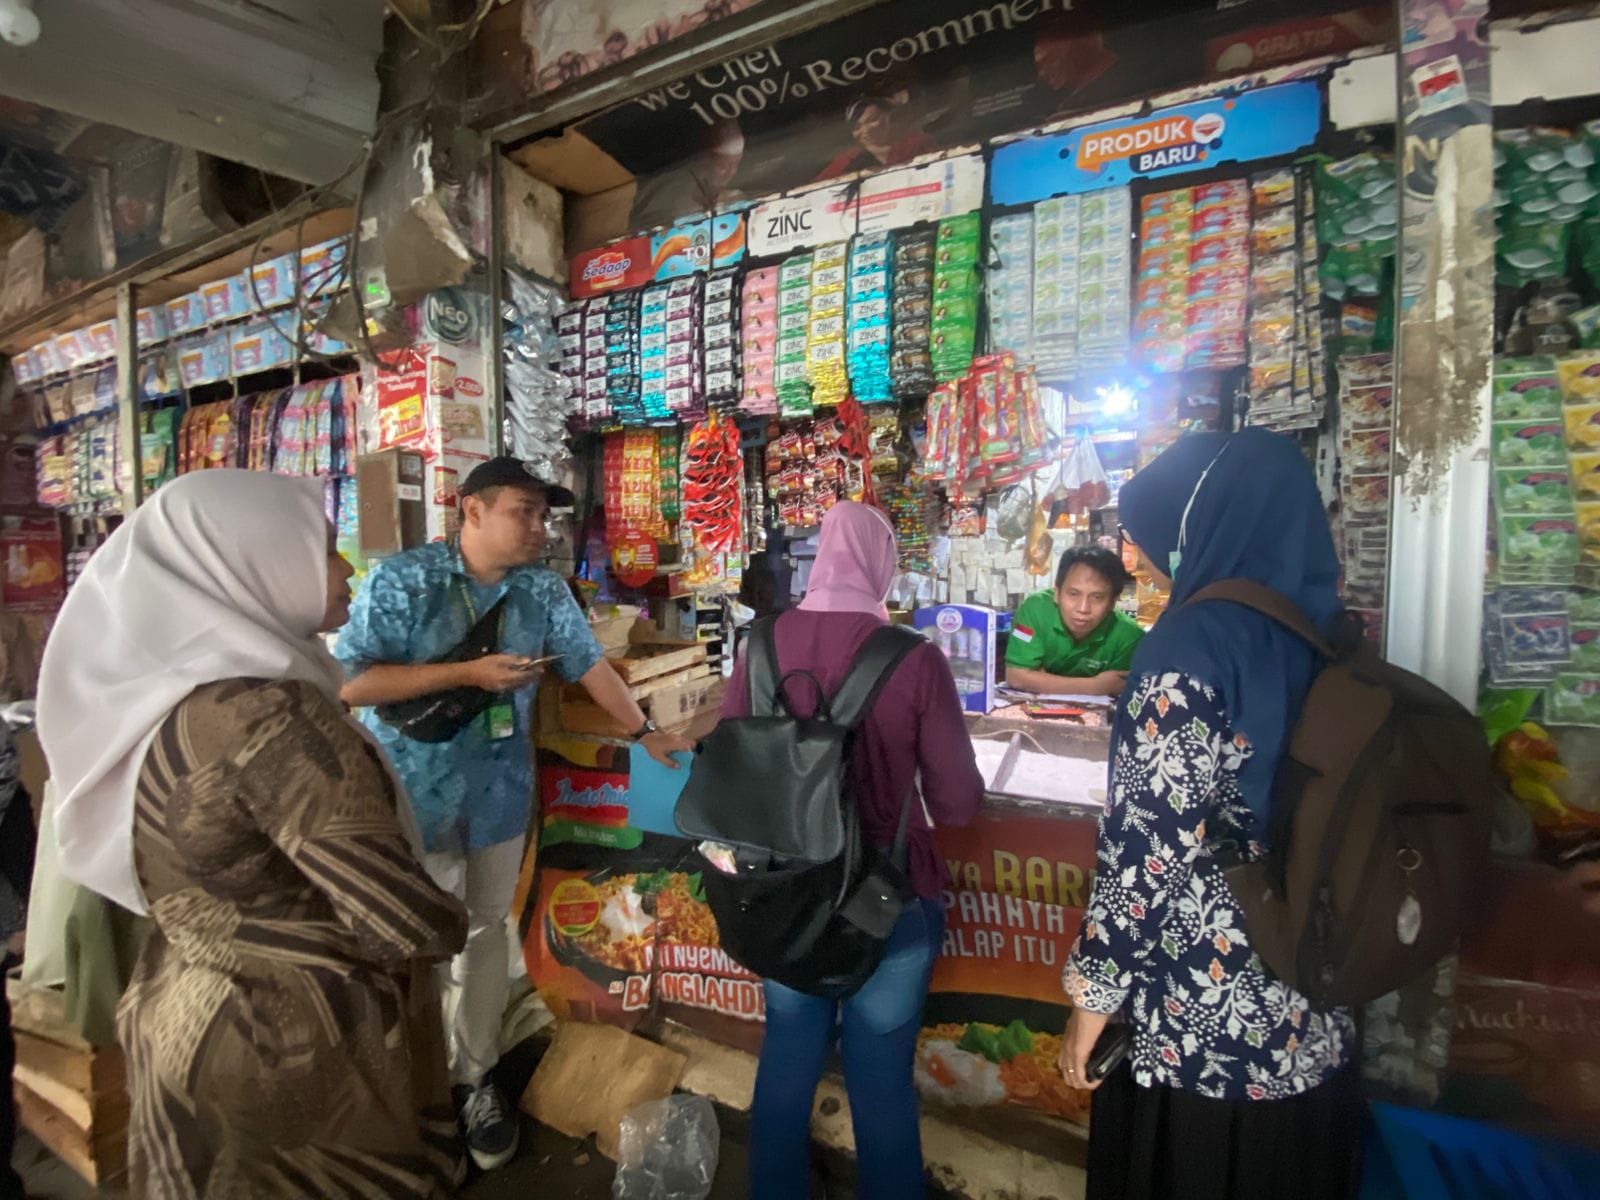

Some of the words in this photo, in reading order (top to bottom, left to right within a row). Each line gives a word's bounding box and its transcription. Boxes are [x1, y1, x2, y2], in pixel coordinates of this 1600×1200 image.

[1255, 27, 1337, 57] GRATIS
[690, 71, 809, 126] 100%
[1085, 120, 1188, 159] PRODUK
[1139, 144, 1197, 171] BARU
[767, 208, 813, 239] ZINC
[820, 247, 838, 258] ZINC
[859, 251, 879, 262] ZINC
[583, 259, 630, 280] Sedaap
[819, 271, 837, 283] ZINC
[858, 276, 879, 288] ZINC
[817, 295, 837, 307] ZINC
[859, 302, 879, 314] ZINC
[430, 296, 468, 325] NEO
[816, 320, 836, 332] ZINC
[859, 328, 879, 341] ZINC
[816, 346, 836, 358] ZINC
[993, 850, 1098, 907] BAR
[1013, 934, 1055, 965] ITU
